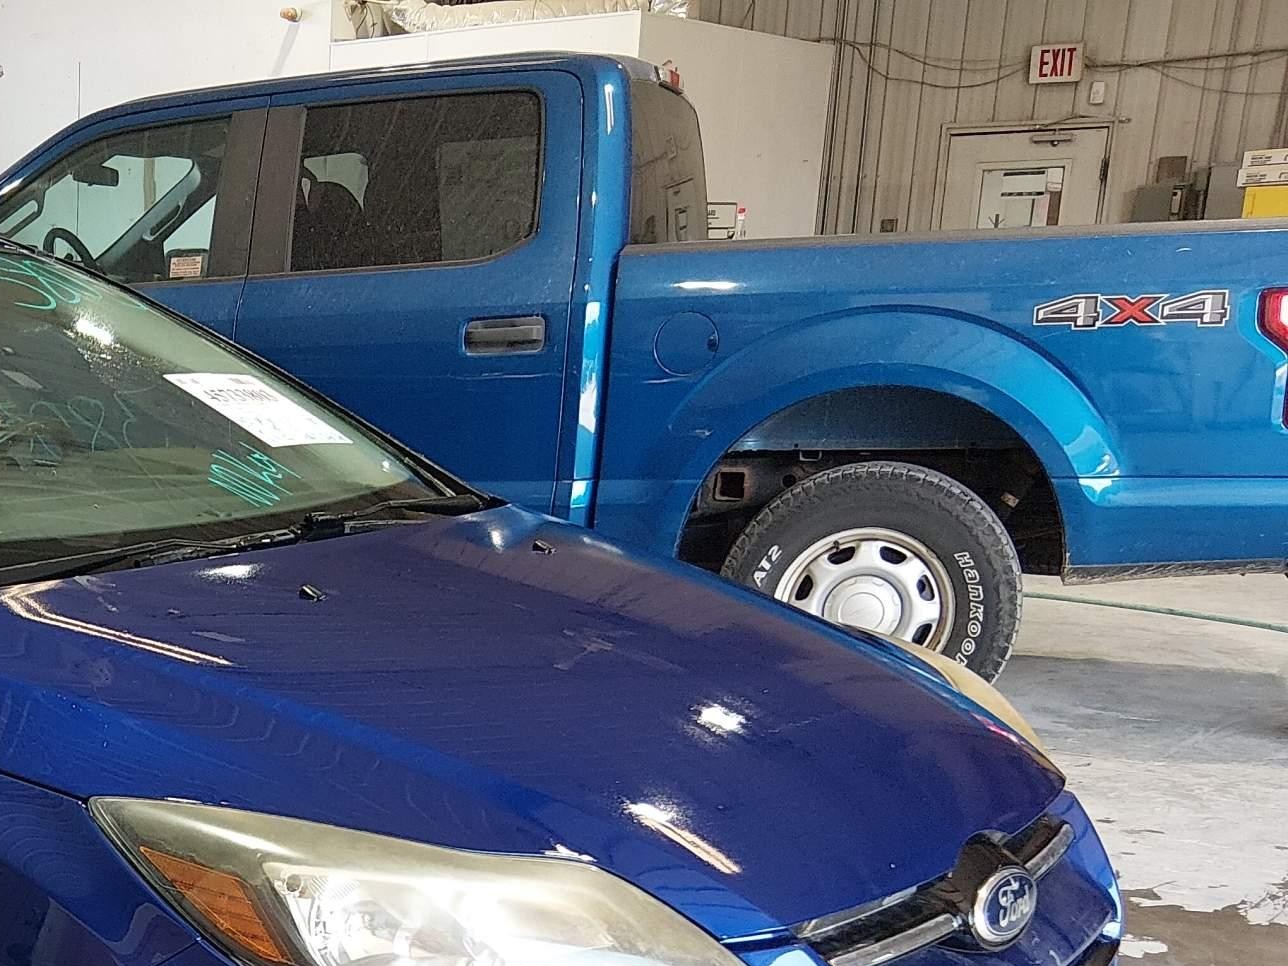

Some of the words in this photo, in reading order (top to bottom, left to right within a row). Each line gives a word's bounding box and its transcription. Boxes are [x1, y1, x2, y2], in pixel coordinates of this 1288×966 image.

[1038, 47, 1077, 78] EXIT
[753, 544, 783, 588] AT2
[998, 876, 1031, 928] Ford
